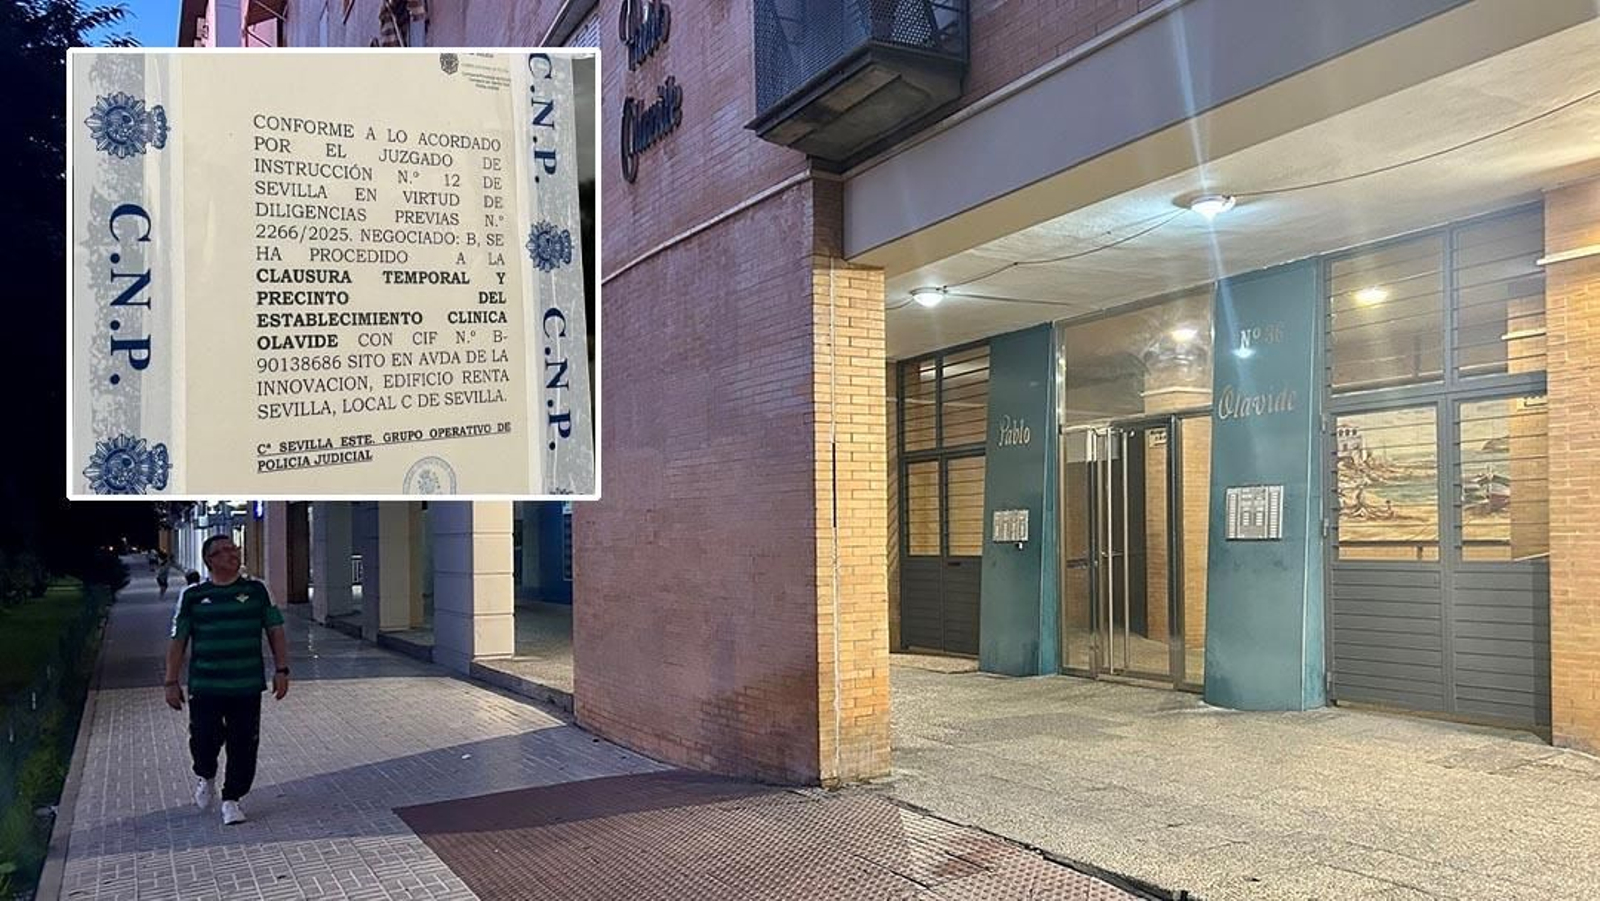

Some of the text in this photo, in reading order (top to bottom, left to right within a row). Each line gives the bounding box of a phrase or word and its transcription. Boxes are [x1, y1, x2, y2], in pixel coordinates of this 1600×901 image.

[254, 115, 501, 151] CONFORME A LO ACORDADO
[254, 136, 501, 171] POR EL JUZGADO DE
[255, 159, 372, 181] INSTRUCCIÓN
[445, 174, 460, 187] 12
[483, 176, 502, 190] DE
[255, 181, 503, 209] SEVILLA EN VIRTUD DE
[255, 203, 366, 223] DILIGENCIAS
[395, 211, 460, 226] PREVIAS
[256, 224, 504, 247] 2266/2025. NEGOCIADO: B, SE
[256, 246, 505, 265] HA PROCEDIDO A LA
[256, 268, 506, 285] CLAUSURA TEMPORAL Y
[110, 204, 151, 385] C.N.P.
[256, 290, 507, 306] PRECINTO DEL
[256, 311, 508, 328] ESTABLECIMIENTO CLINICA
[257, 333, 338, 351] OLAVIDE
[358, 332, 393, 347] CON
[413, 331, 438, 345] CIF
[493, 330, 508, 343] B-
[257, 349, 508, 374] 90138686 SITO EN AVDA DE LA
[257, 369, 510, 396] INNOVACION, EDIFICIO RENTA
[543, 308, 571, 450] C.N.P.
[258, 389, 507, 419] SEVILLA, LOCAL C DE SEVILLA.
[1219, 384, 1297, 419] Olavide
[279, 438, 334, 453] SEVILLA
[341, 434, 375, 448] ESTE.
[383, 429, 423, 442] GRUPO
[429, 424, 491, 439] OPERATIVO
[497, 422, 512, 432] DE
[999, 414, 1031, 446] Pablo
[257, 450, 374, 472] POLICIA JUDICIAL
